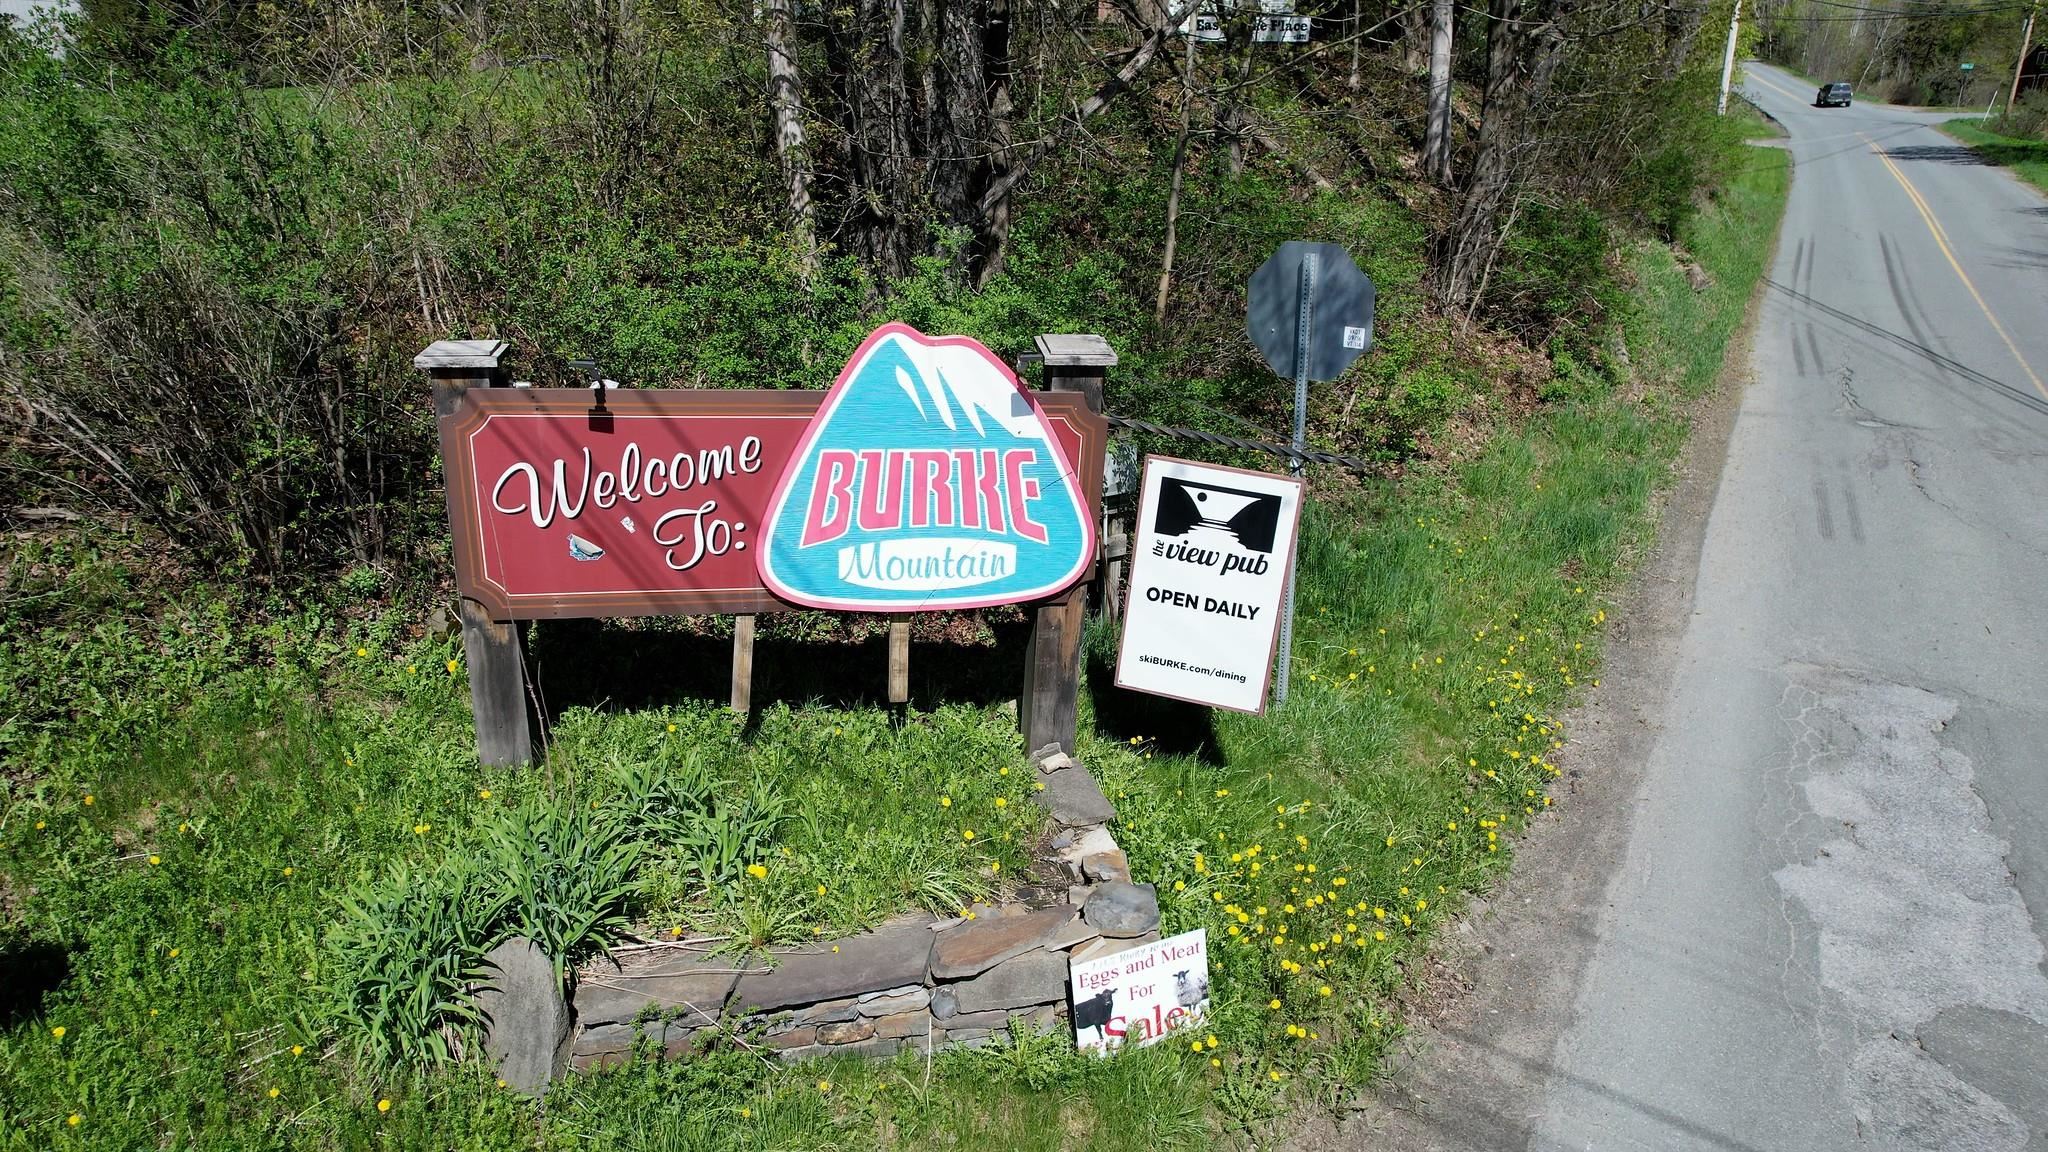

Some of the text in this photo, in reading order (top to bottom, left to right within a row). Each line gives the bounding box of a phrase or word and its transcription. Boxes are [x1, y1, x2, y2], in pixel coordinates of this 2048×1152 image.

[1196, 19, 1219, 31] Eas
[1270, 19, 1308, 32] Place
[492, 435, 763, 529] Welcome
[798, 448, 1049, 549] BURKE
[653, 499, 746, 572] To:
[838, 540, 1009, 581] Mountain
[1152, 539, 1269, 576] the view pub
[1146, 586, 1260, 621] OPEN DAILY
[1139, 653, 1247, 684] skiBURKE.com/dining
[1079, 968, 1119, 990] Eggs
[1126, 954, 1155, 975] and
[1161, 942, 1201, 962] Meat
[1129, 983, 1156, 1001] For
[1104, 1004, 1186, 1043] Sale
